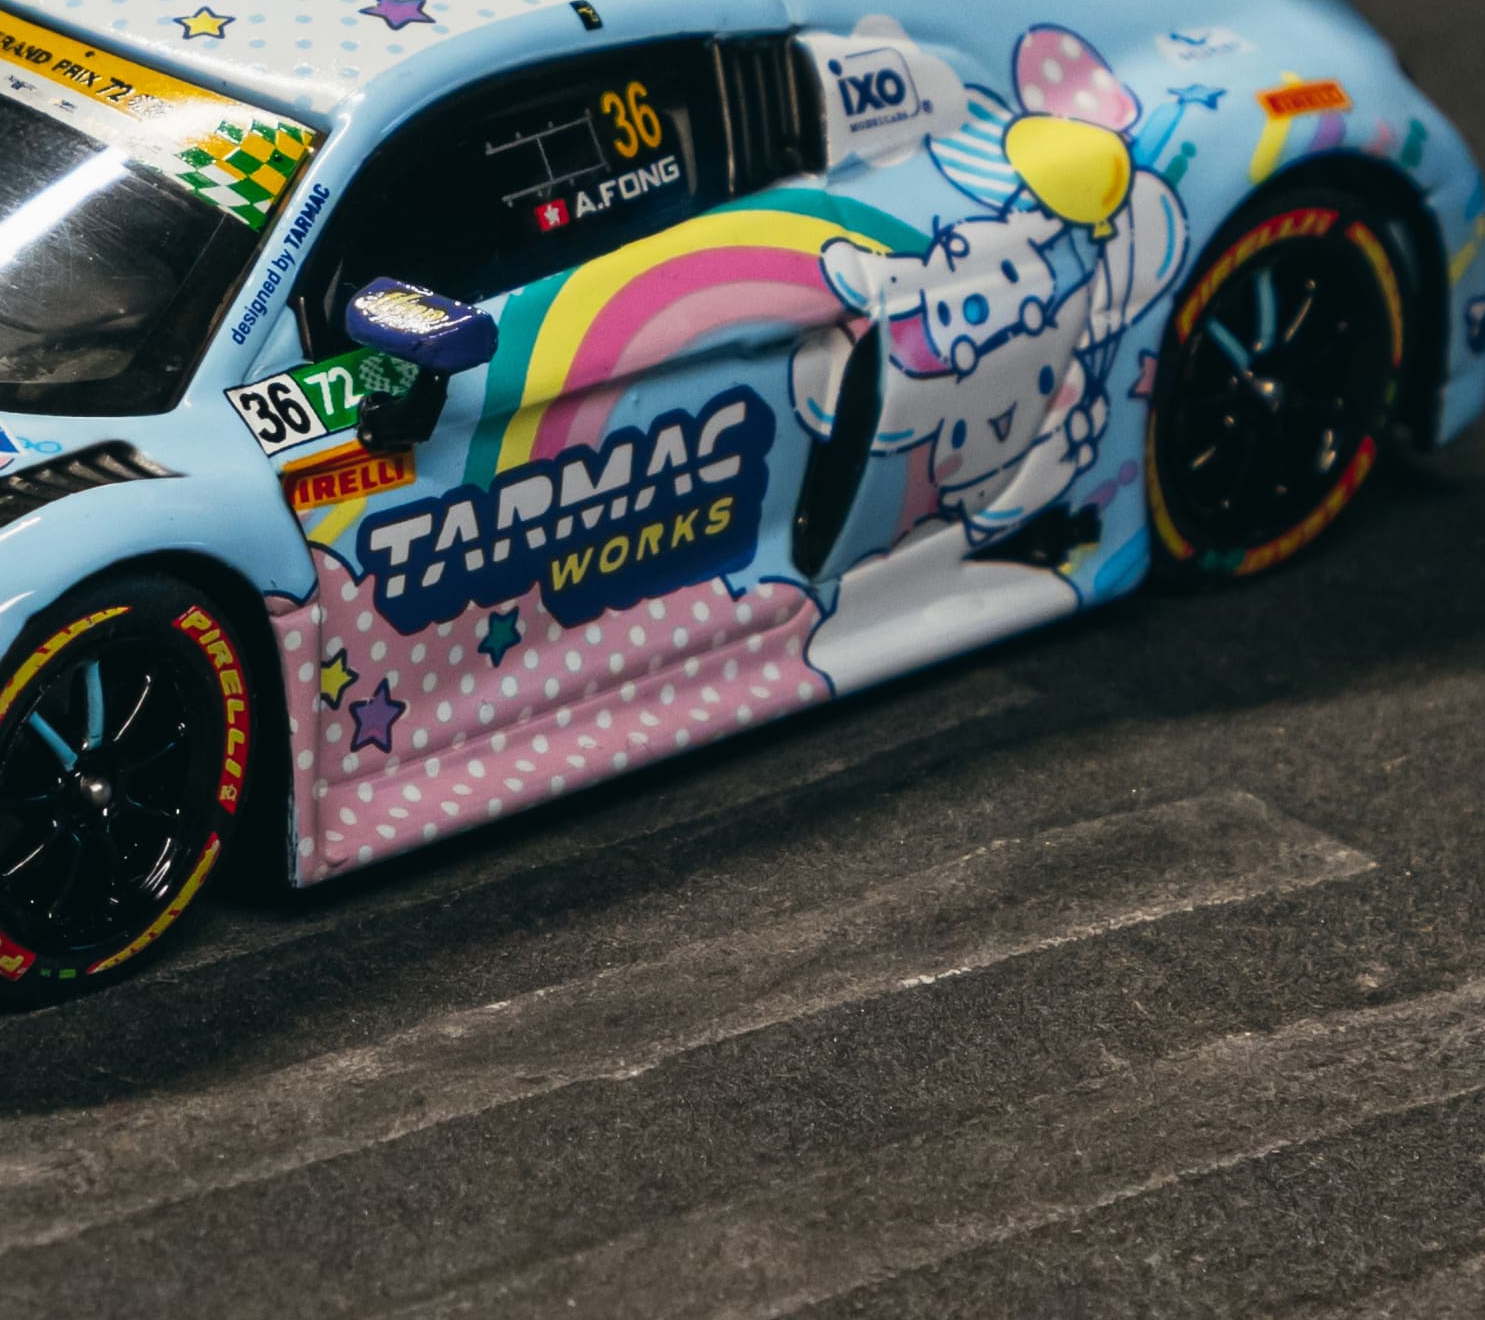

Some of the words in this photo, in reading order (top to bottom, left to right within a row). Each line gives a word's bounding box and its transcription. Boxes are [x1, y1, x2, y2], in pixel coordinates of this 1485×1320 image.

[52, 58, 102, 89] PRIX
[96, 76, 136, 102] 72
[827, 57, 906, 117] ixo
[601, 80, 663, 159] 36
[283, 183, 331, 250] TARMAC
[575, 155, 681, 219] A.FONG
[271, 248, 296, 273] by
[231, 268, 282, 346] designed
[239, 381, 312, 444] 36
[303, 366, 366, 416] 72
[369, 400, 747, 600] TARMAC
[550, 496, 734, 593] WORKS
[180, 609, 246, 779] PIRELLI
